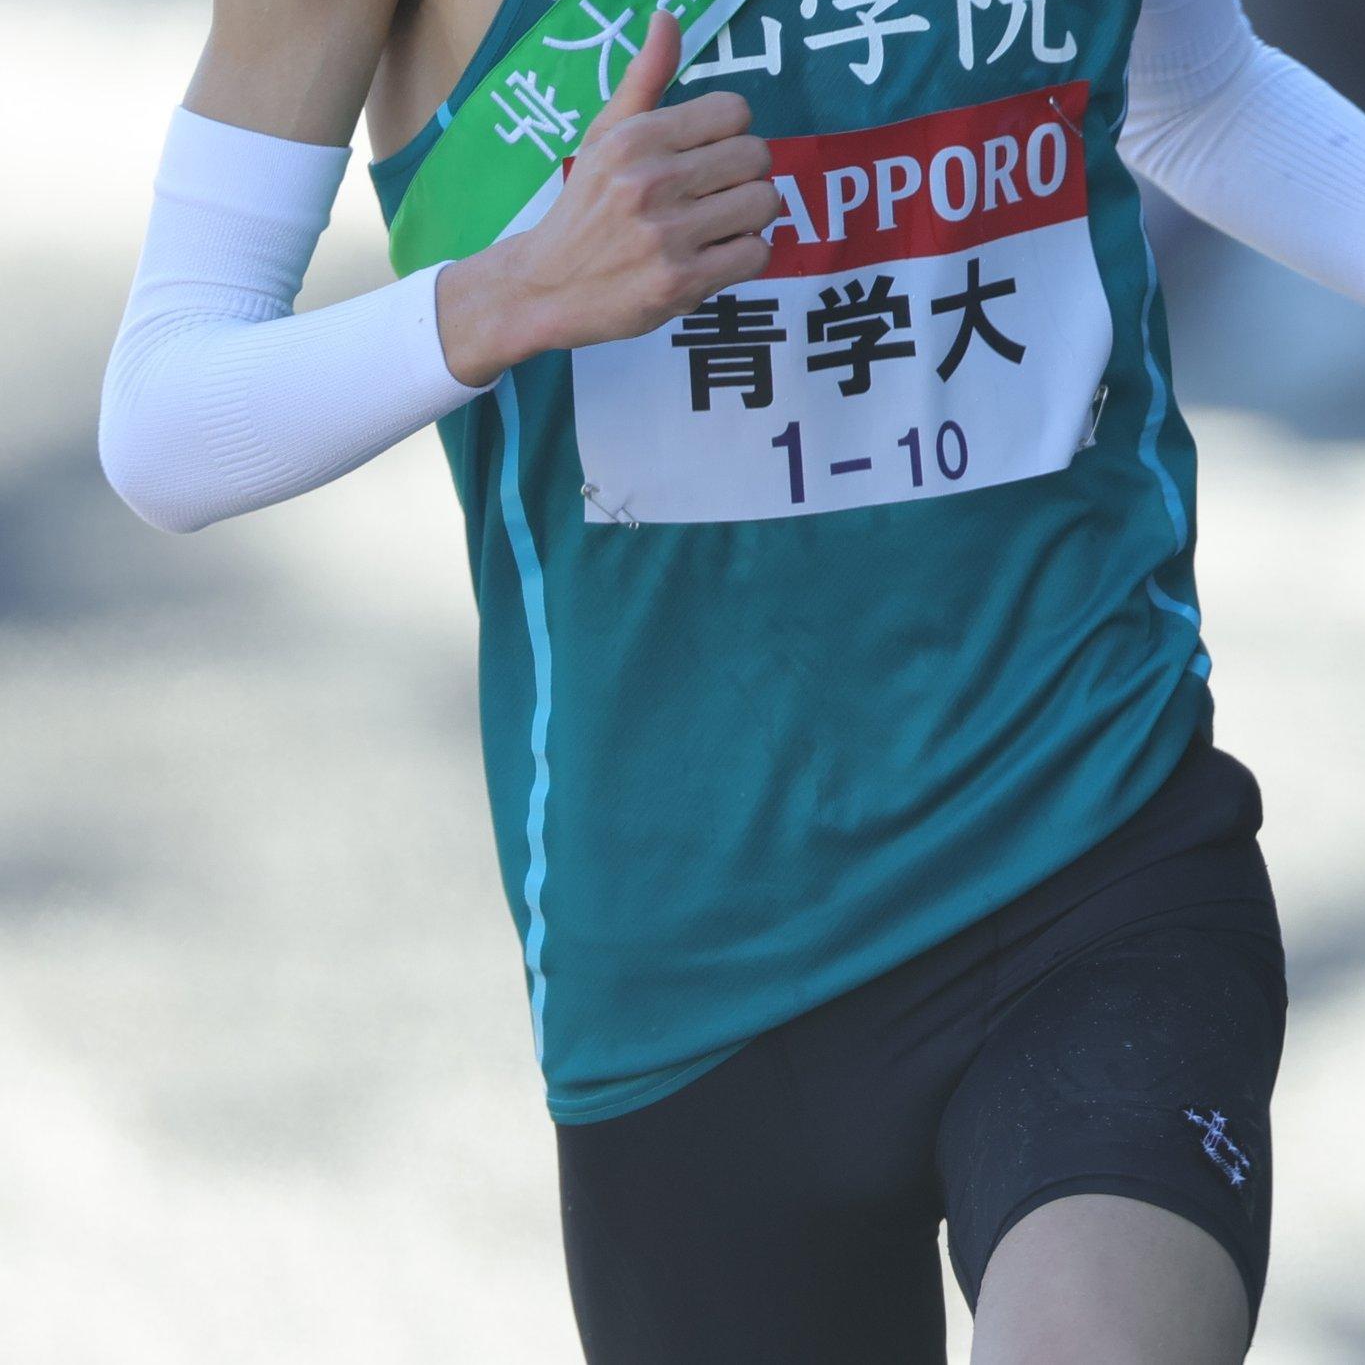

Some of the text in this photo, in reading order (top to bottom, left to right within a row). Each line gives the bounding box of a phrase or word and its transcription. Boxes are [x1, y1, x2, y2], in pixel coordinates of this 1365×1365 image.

[762, 121, 1069, 246] APPORO
[671, 258, 1027, 413] 青学大
[771, 419, 970, 504] 1-10
